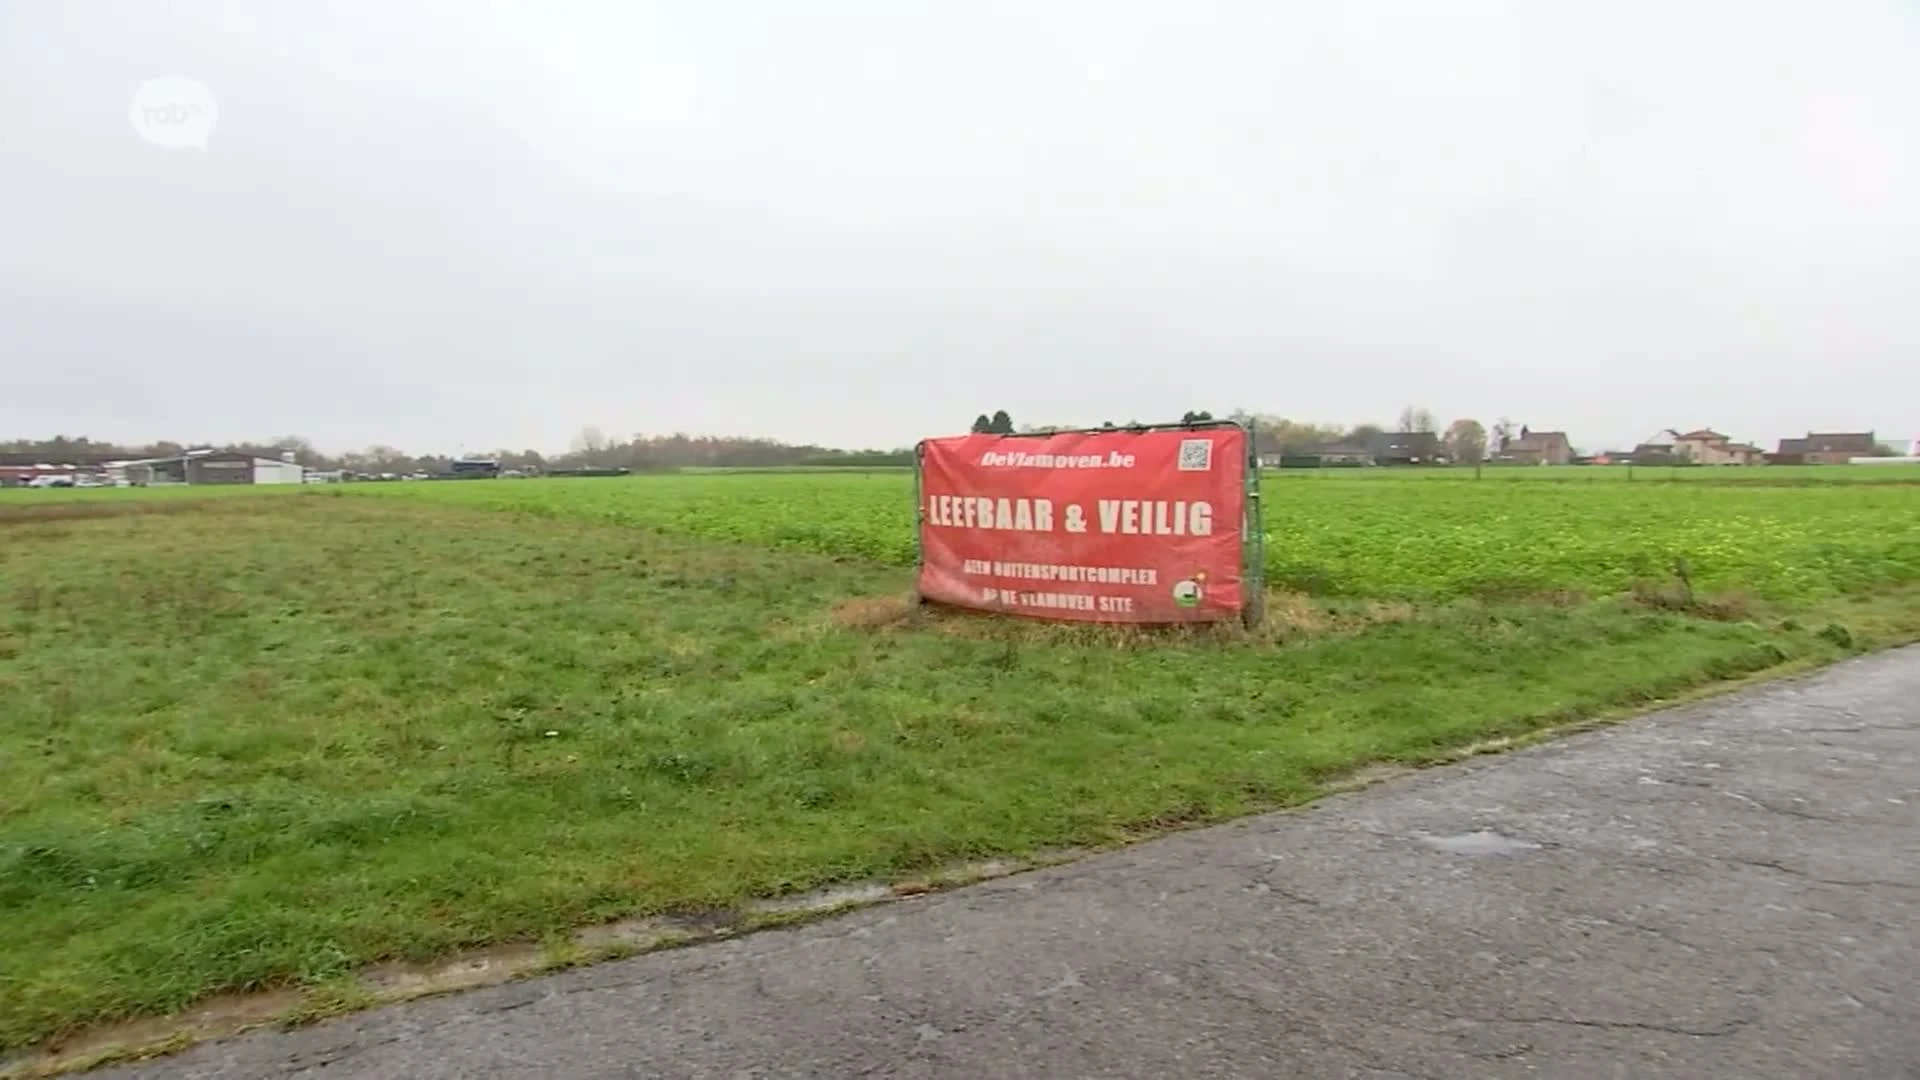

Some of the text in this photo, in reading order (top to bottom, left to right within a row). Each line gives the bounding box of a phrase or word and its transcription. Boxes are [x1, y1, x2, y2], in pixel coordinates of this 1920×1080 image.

[981, 451, 1136, 469] DeVlamoven.be
[929, 495, 1212, 536] LEEFBAAR & VEILIG
[1099, 597, 1133, 612] SITE
